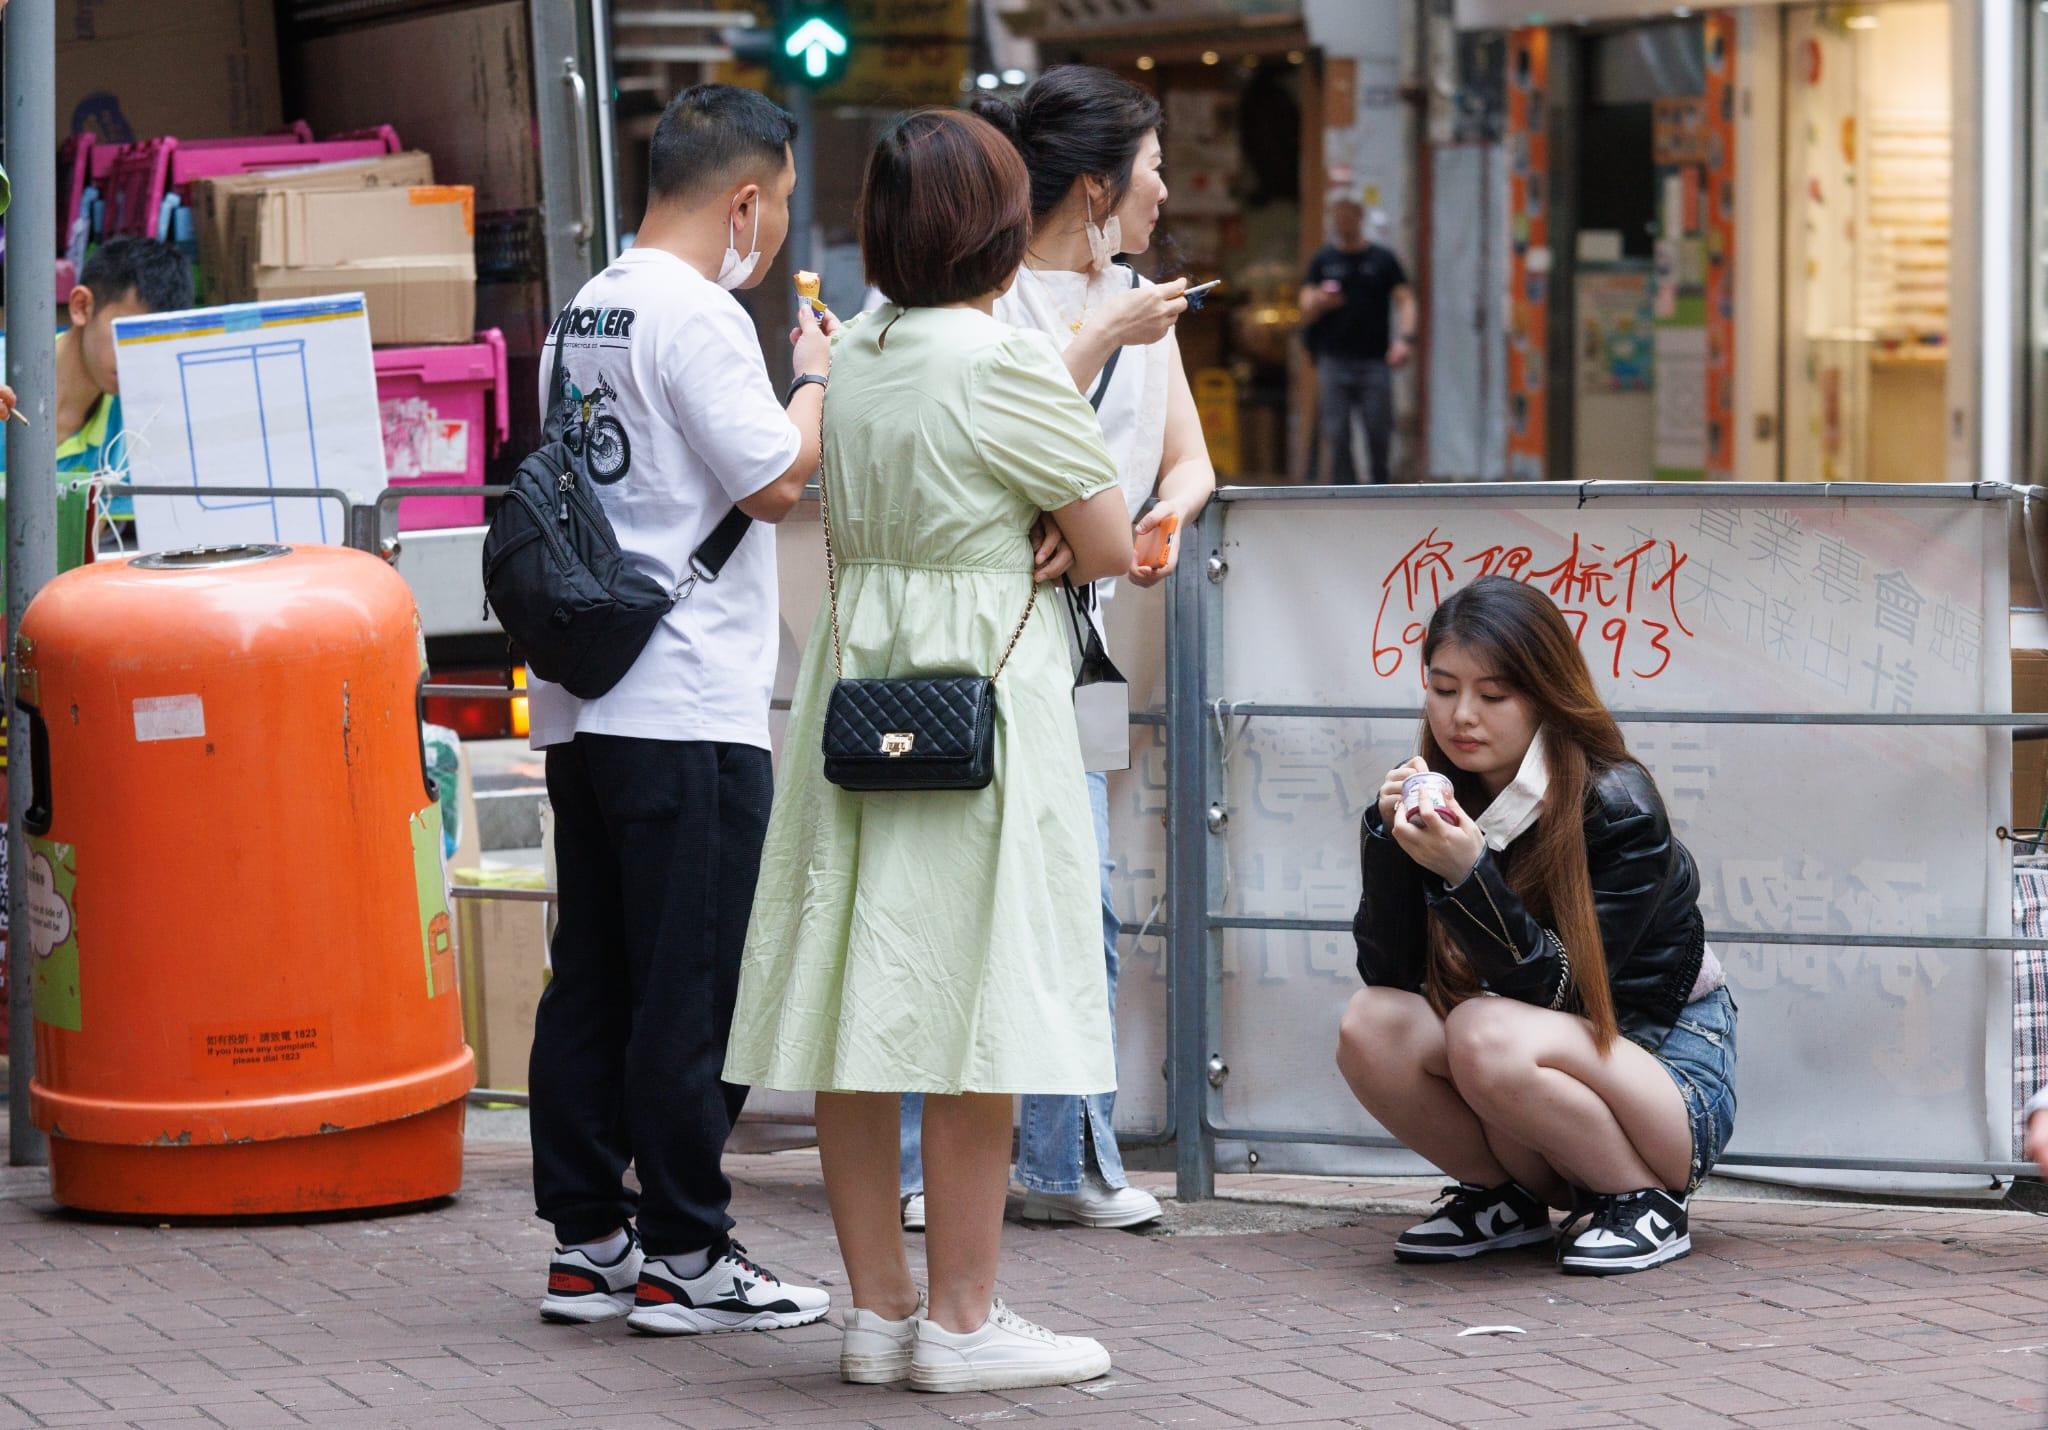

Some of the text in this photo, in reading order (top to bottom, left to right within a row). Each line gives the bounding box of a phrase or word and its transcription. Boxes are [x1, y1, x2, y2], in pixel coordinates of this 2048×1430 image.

[294, 1028, 317, 1039] 1823
[215, 1048, 231, 1056] you
[233, 1046, 254, 1054] have
[256, 1046, 272, 1054] any
[233, 1053, 300, 1065] please dial 1823
